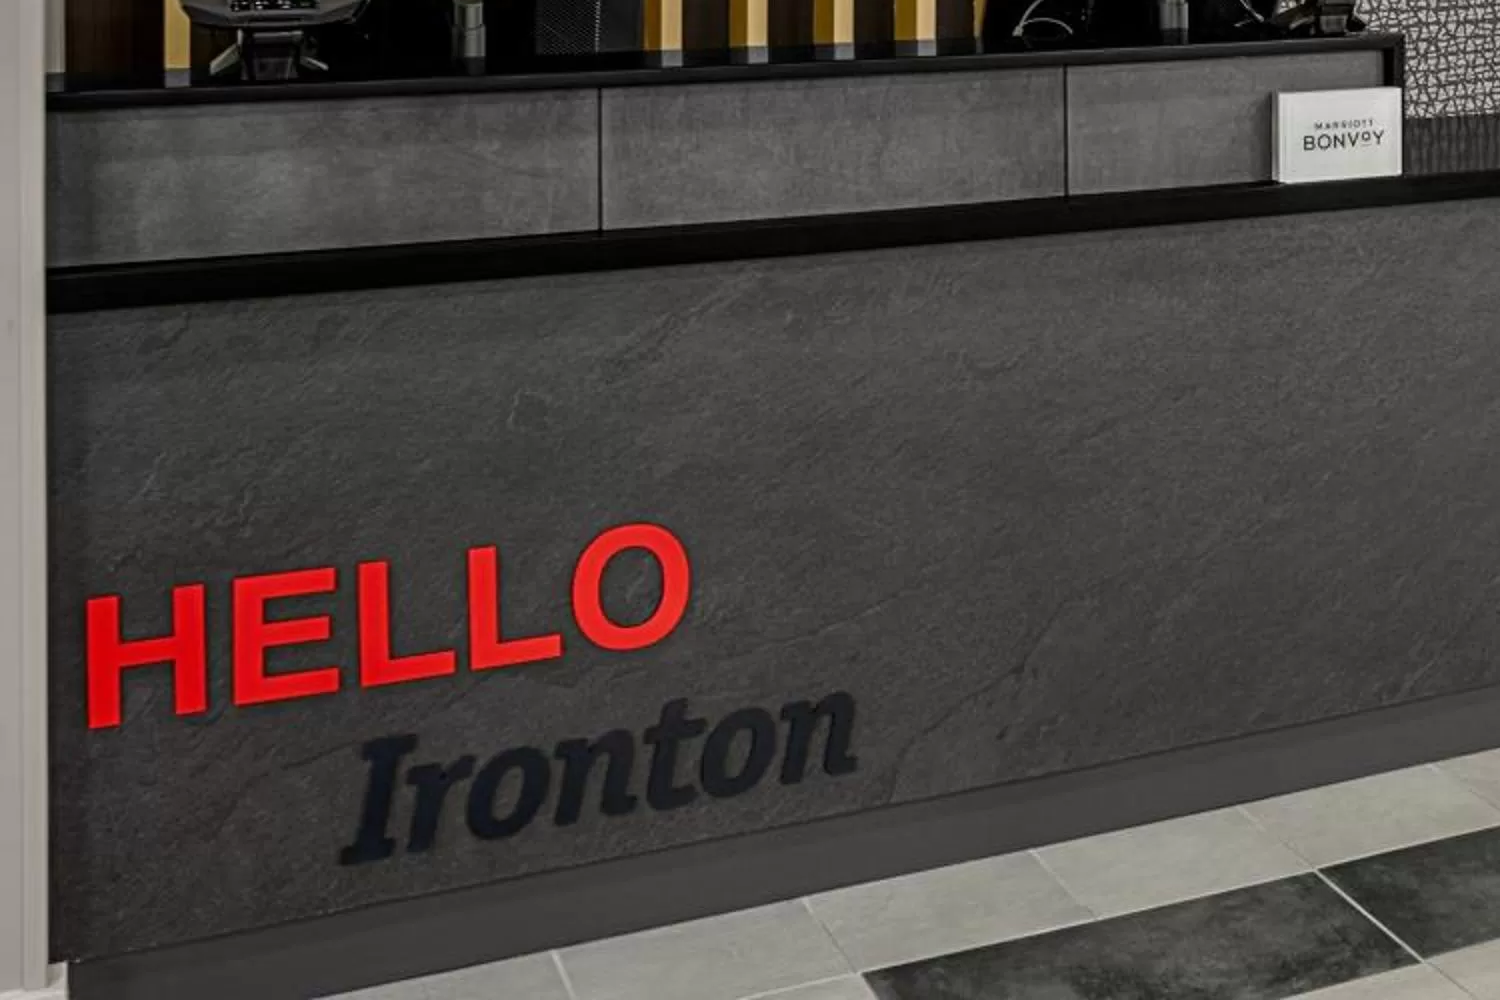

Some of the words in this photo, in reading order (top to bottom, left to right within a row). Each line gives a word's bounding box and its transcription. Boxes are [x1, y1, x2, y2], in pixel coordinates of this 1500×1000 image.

[1303, 129, 1385, 151] BONVOY
[86, 522, 691, 729] HELLO
[338, 688, 860, 868] Ironton
